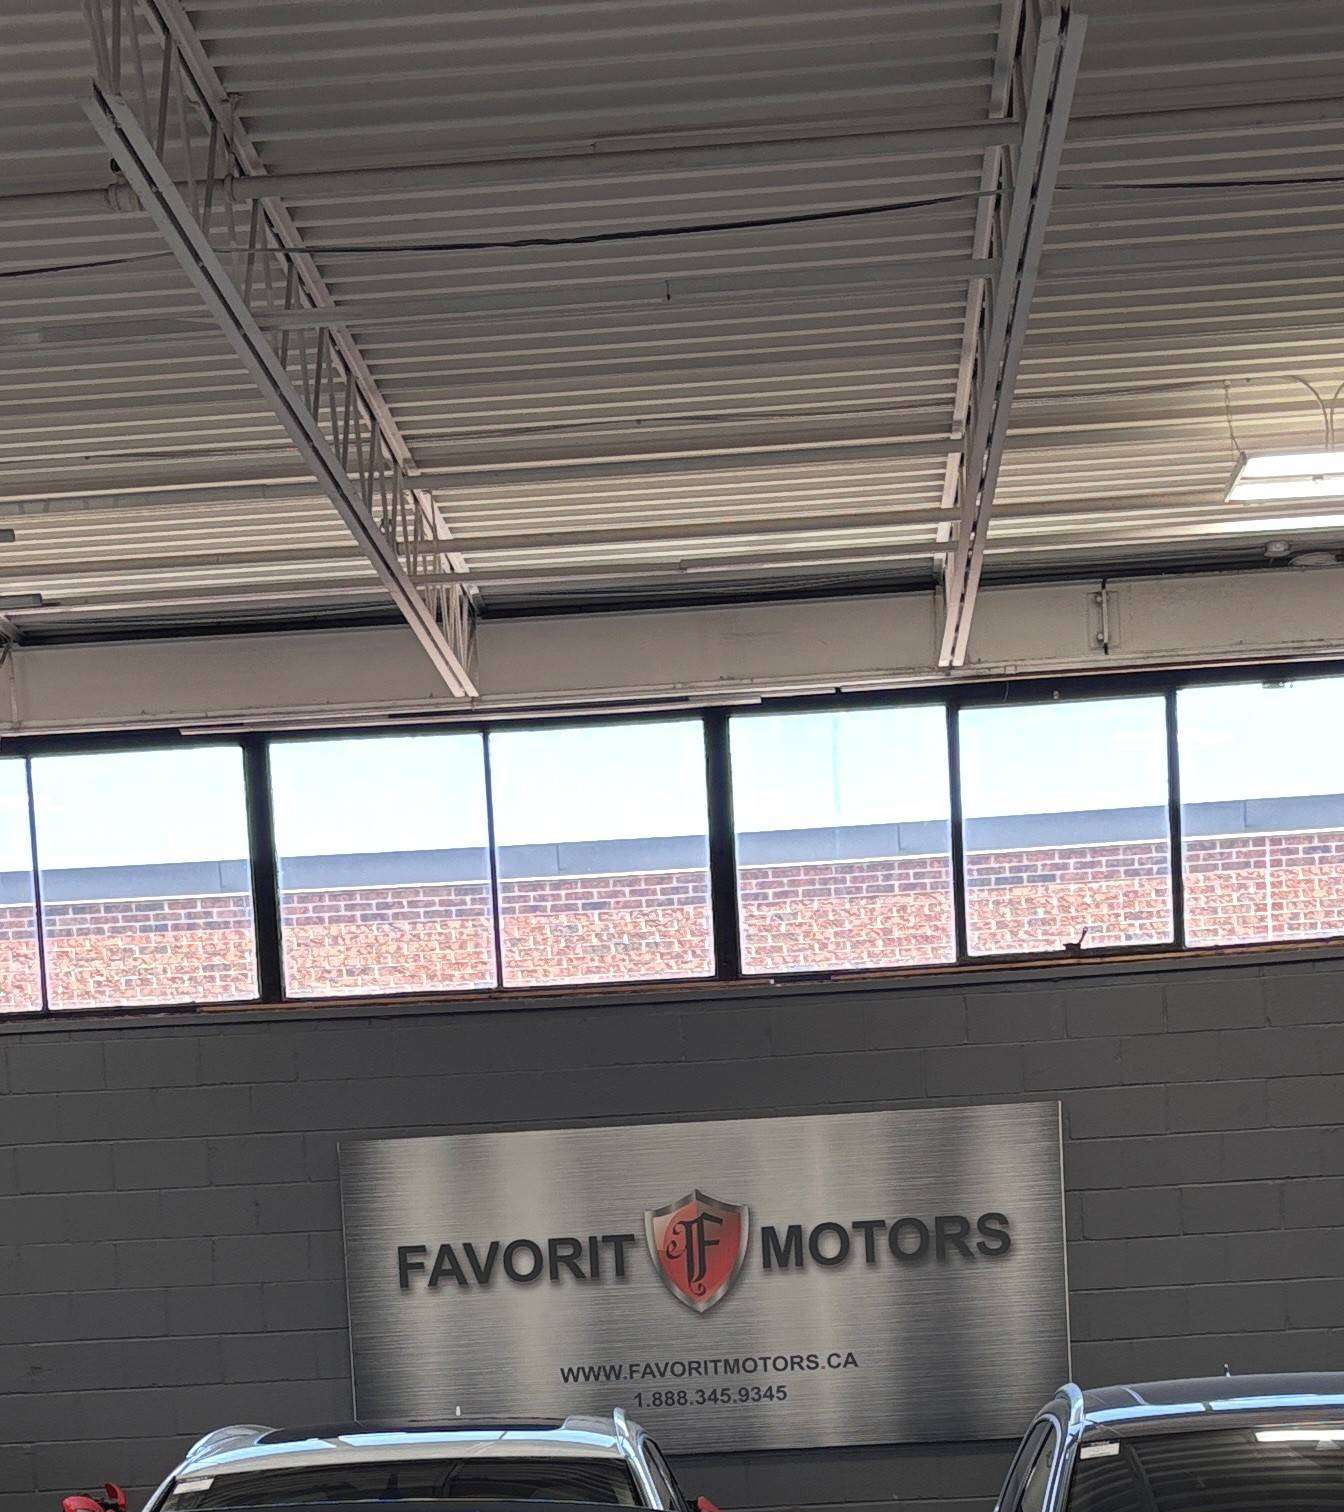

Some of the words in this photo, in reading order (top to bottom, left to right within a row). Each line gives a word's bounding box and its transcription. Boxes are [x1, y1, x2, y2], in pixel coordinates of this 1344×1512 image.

[397, 1233, 636, 1290] FAVORIT
[761, 1212, 1012, 1269] MOTORS
[560, 1351, 859, 1384] WWW.FAVORITMOTORS.CA
[633, 1384, 788, 1408] 1.888.345.9345
